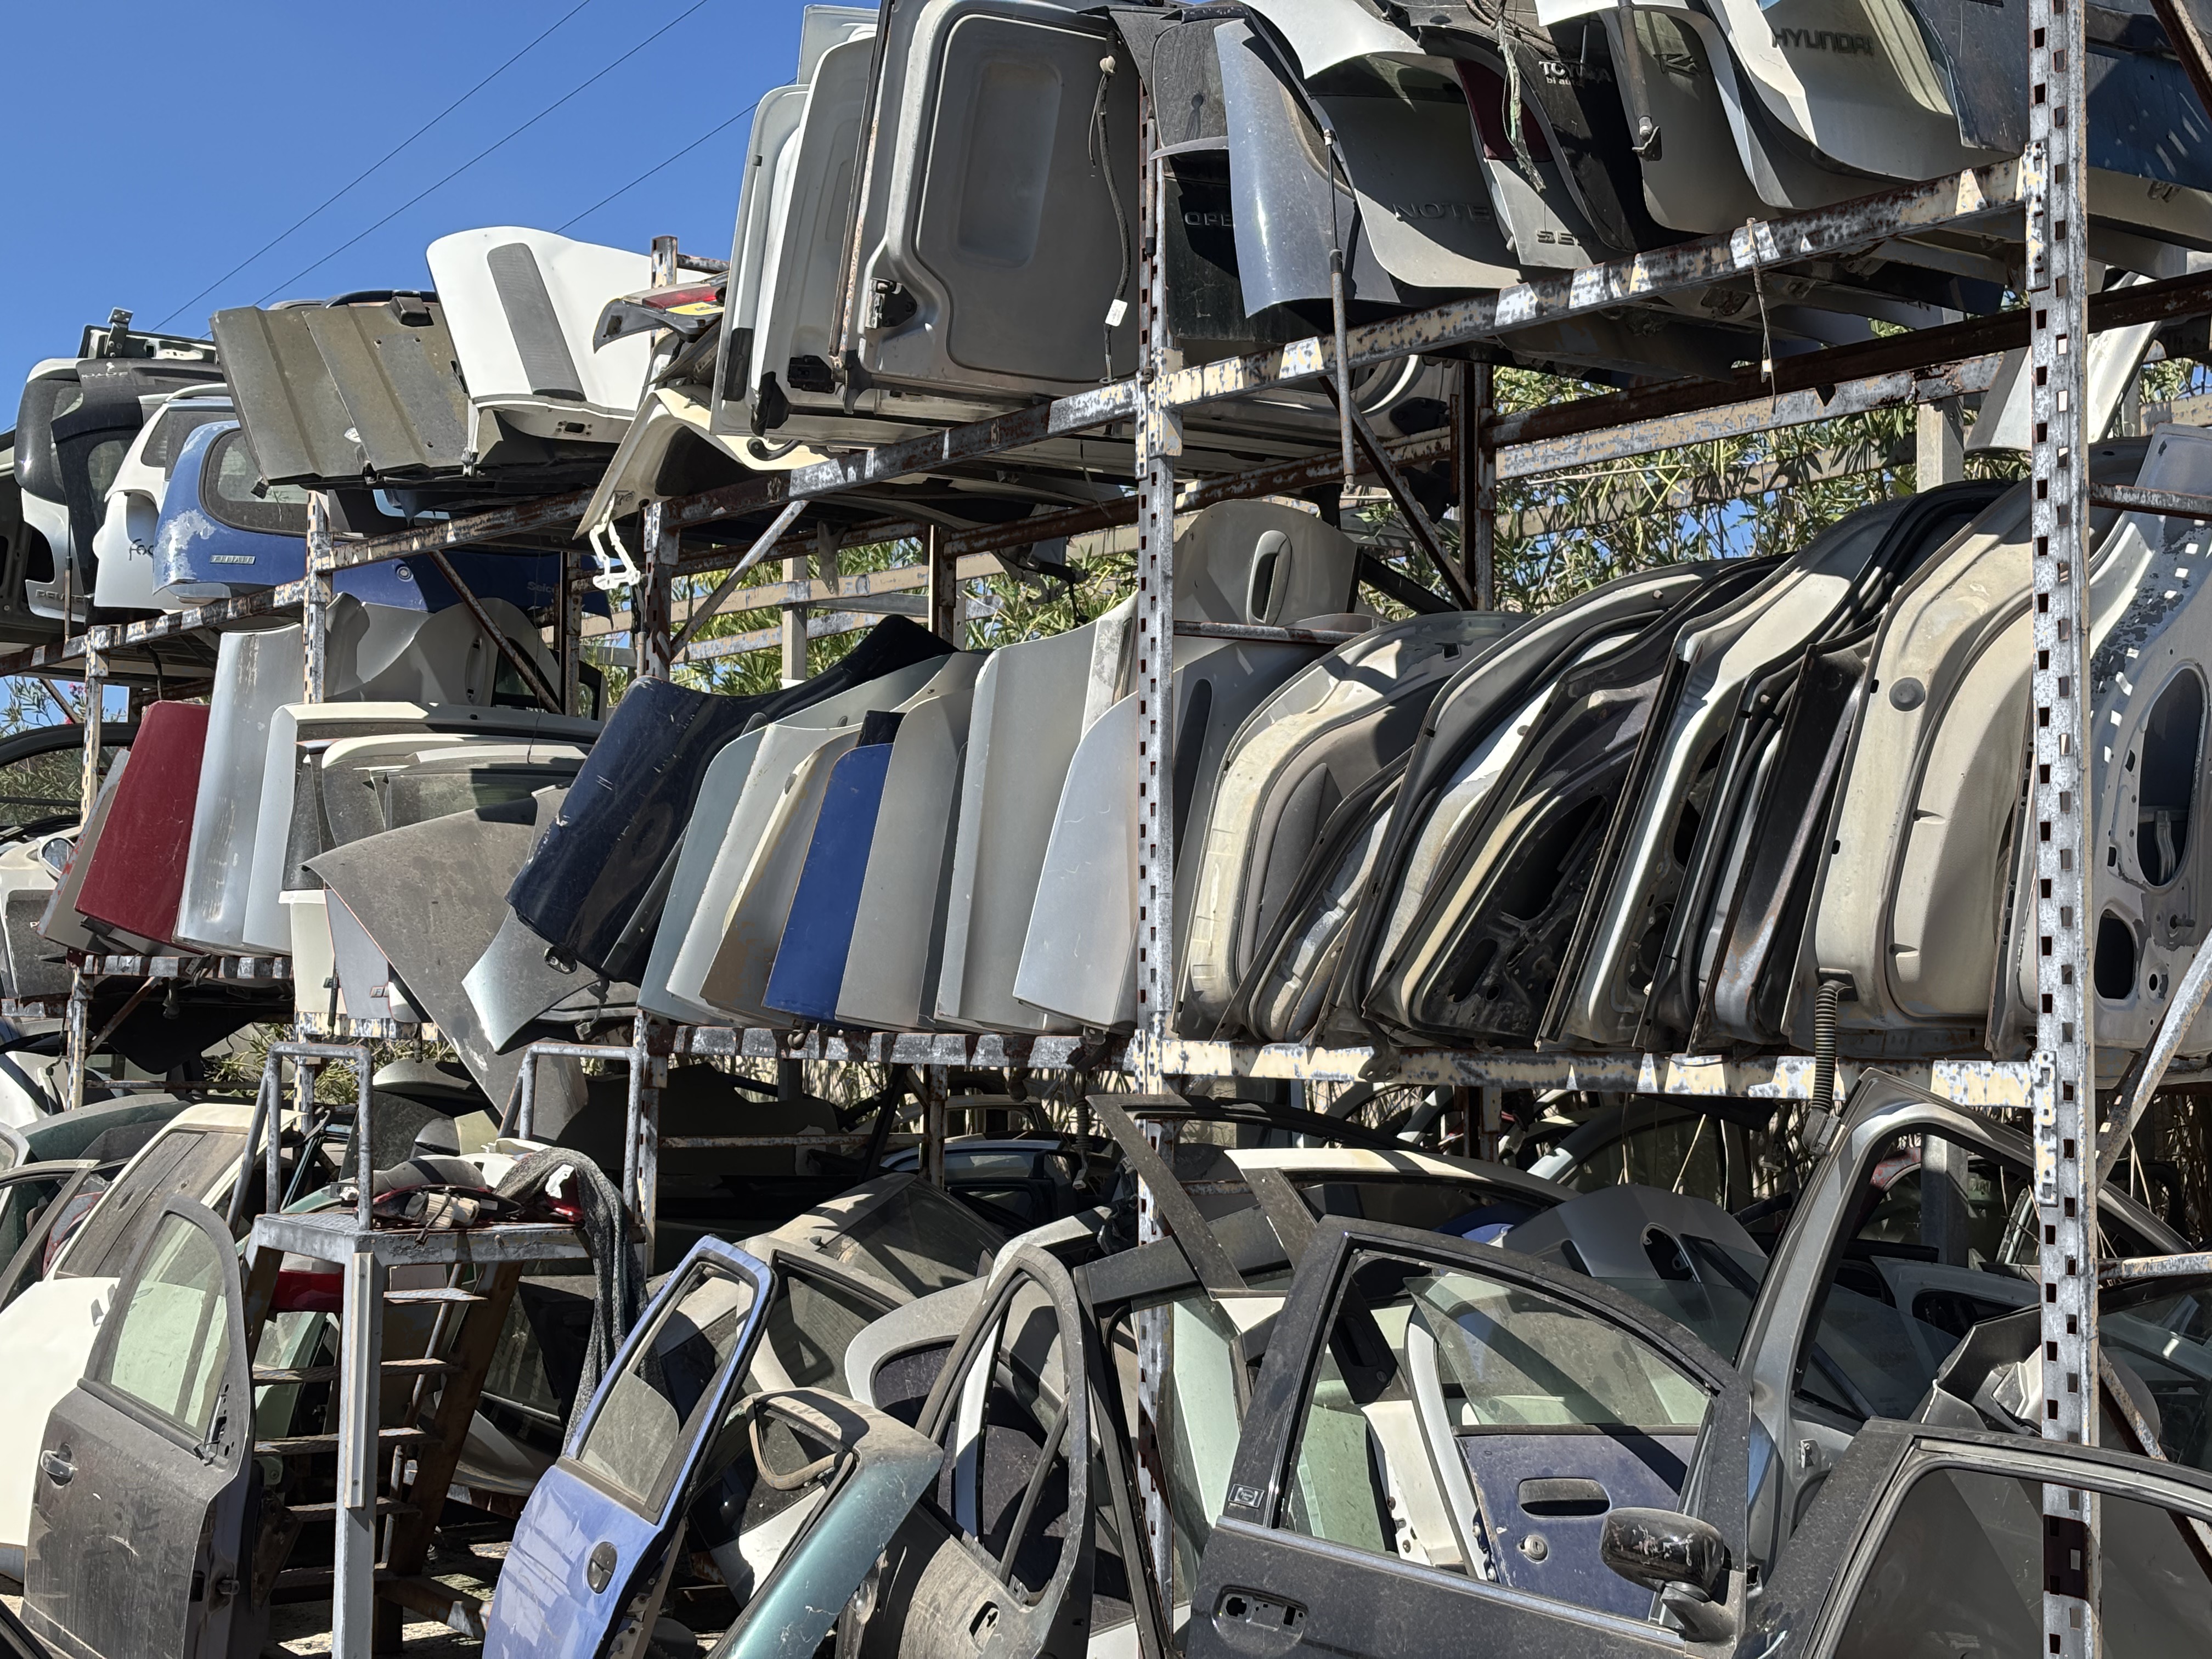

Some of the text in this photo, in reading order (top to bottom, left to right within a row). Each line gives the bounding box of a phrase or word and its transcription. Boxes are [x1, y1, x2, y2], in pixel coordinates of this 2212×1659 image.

[1771, 28, 1875, 55] HYUNDAI
[1539, 61, 1612, 83] TOYA
[1392, 203, 1490, 222] NOTE
[211, 555, 256, 565] FIAT
